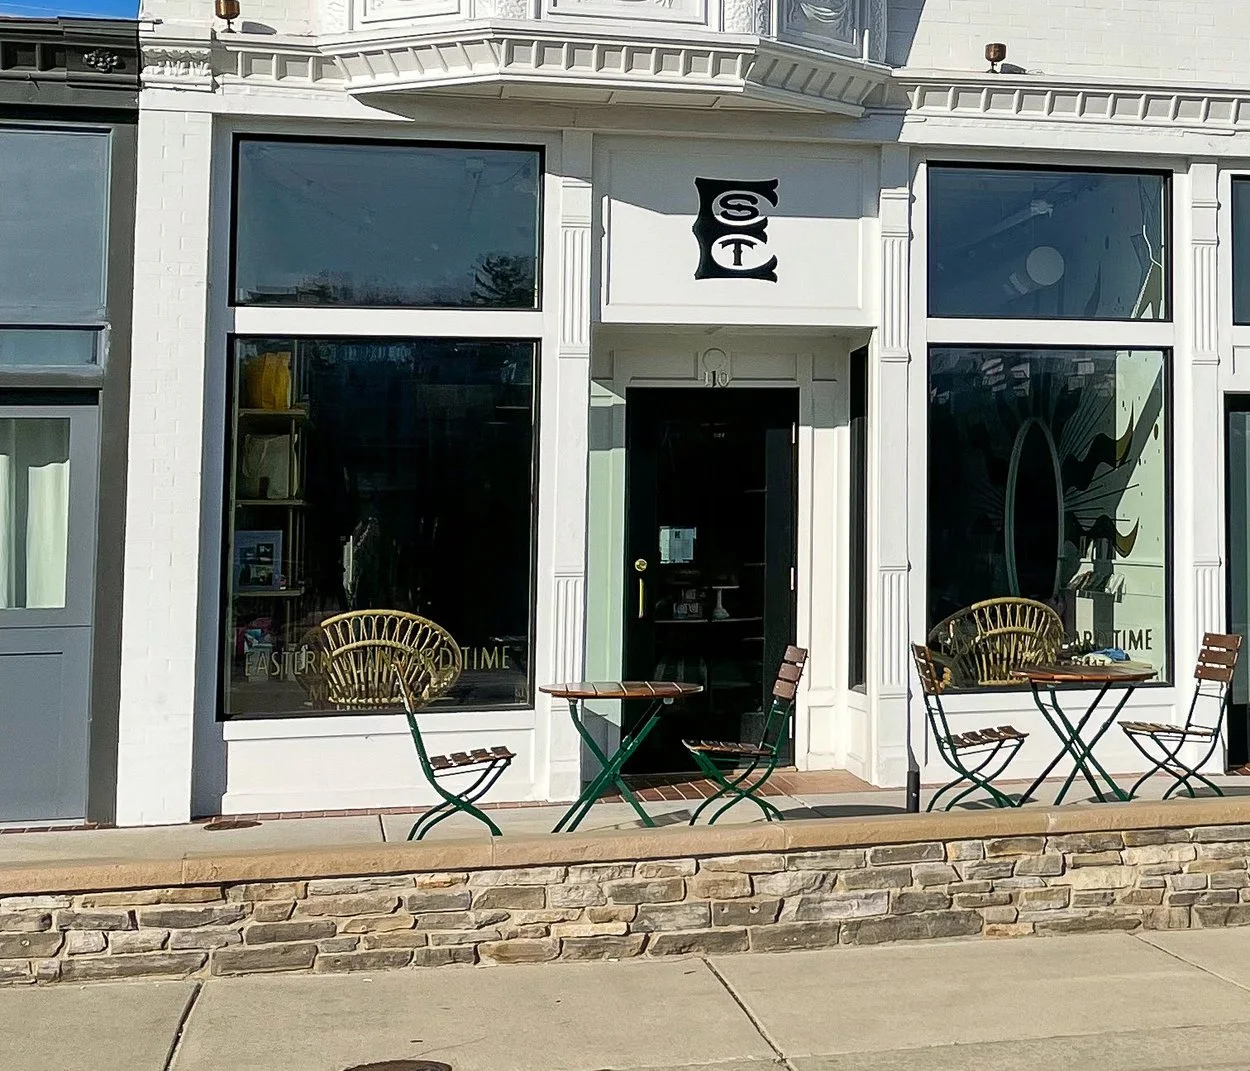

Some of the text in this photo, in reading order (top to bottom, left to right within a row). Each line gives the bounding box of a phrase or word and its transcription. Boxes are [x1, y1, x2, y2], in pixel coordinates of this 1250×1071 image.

[704, 370, 729, 388] 110
[1113, 628, 1153, 651] TIME
[244, 649, 333, 677] EASTERN
[460, 645, 510, 670] TIME
